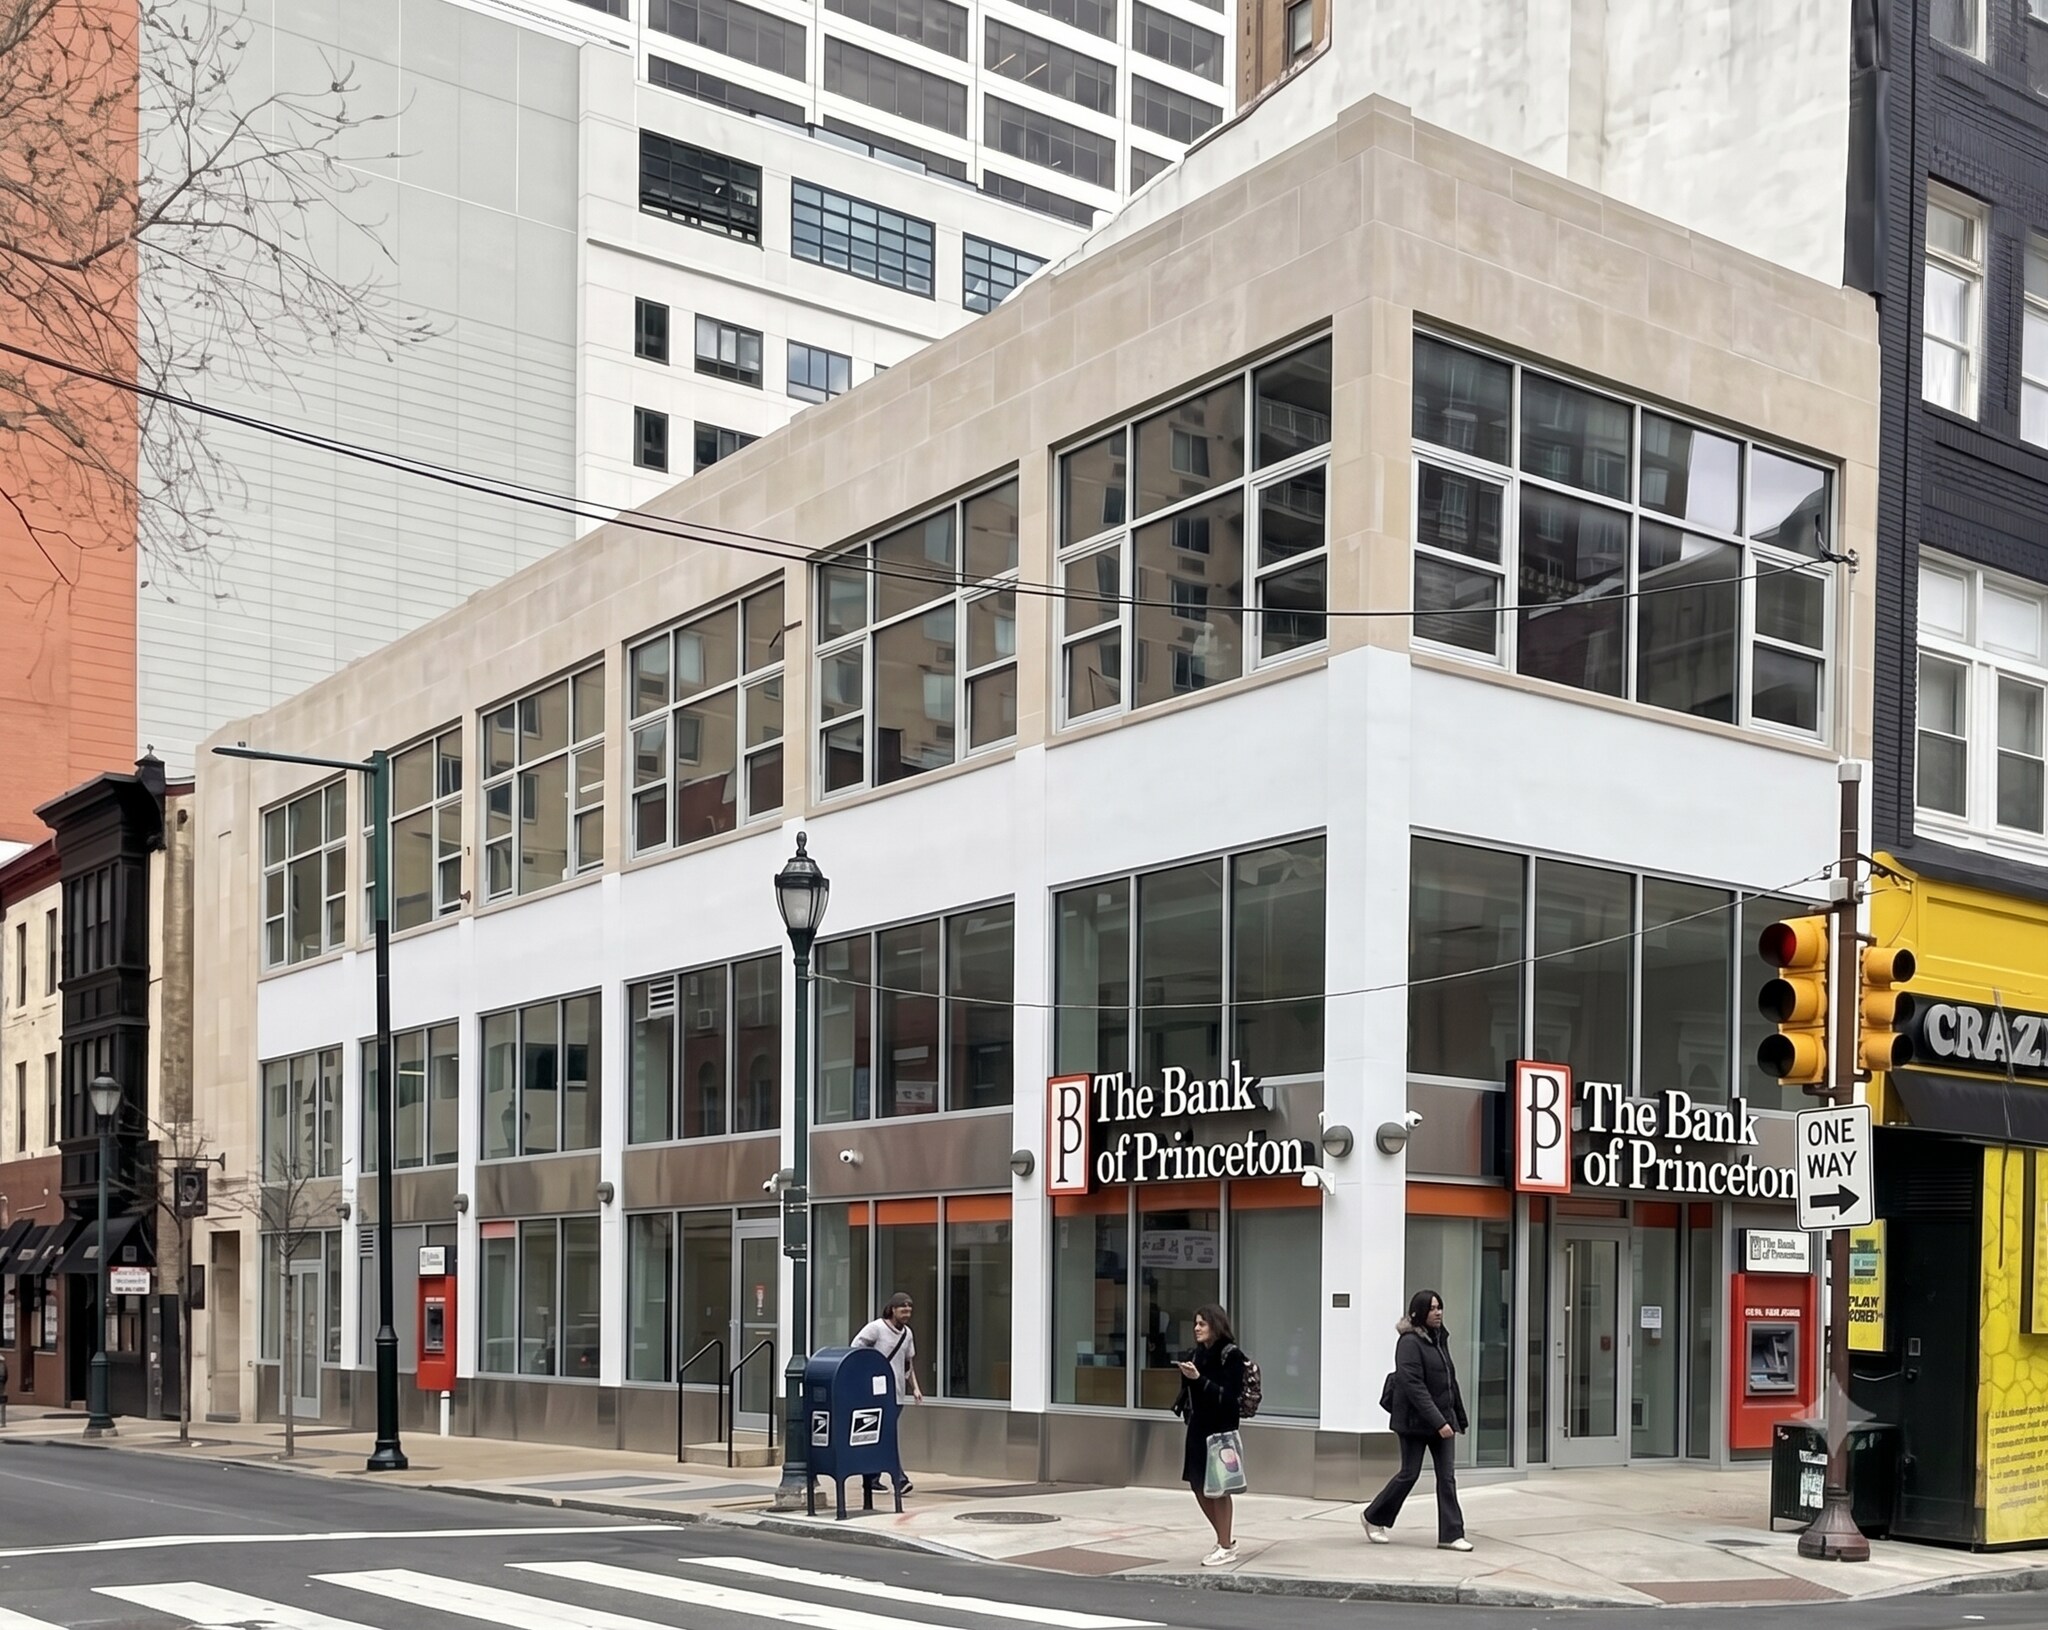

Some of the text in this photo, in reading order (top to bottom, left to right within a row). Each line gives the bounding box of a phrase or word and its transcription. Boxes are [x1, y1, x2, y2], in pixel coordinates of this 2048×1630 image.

[1924, 1004, 2048, 1068] CRAZ
[1094, 1059, 1256, 1122] The Bank
[1583, 1081, 1760, 1146] The Bank
[1096, 1130, 1304, 1184] of Princeton
[1807, 1117, 1855, 1146] ONE
[1584, 1137, 1797, 1199] of Princeton
[1807, 1151, 1858, 1179] WAY
